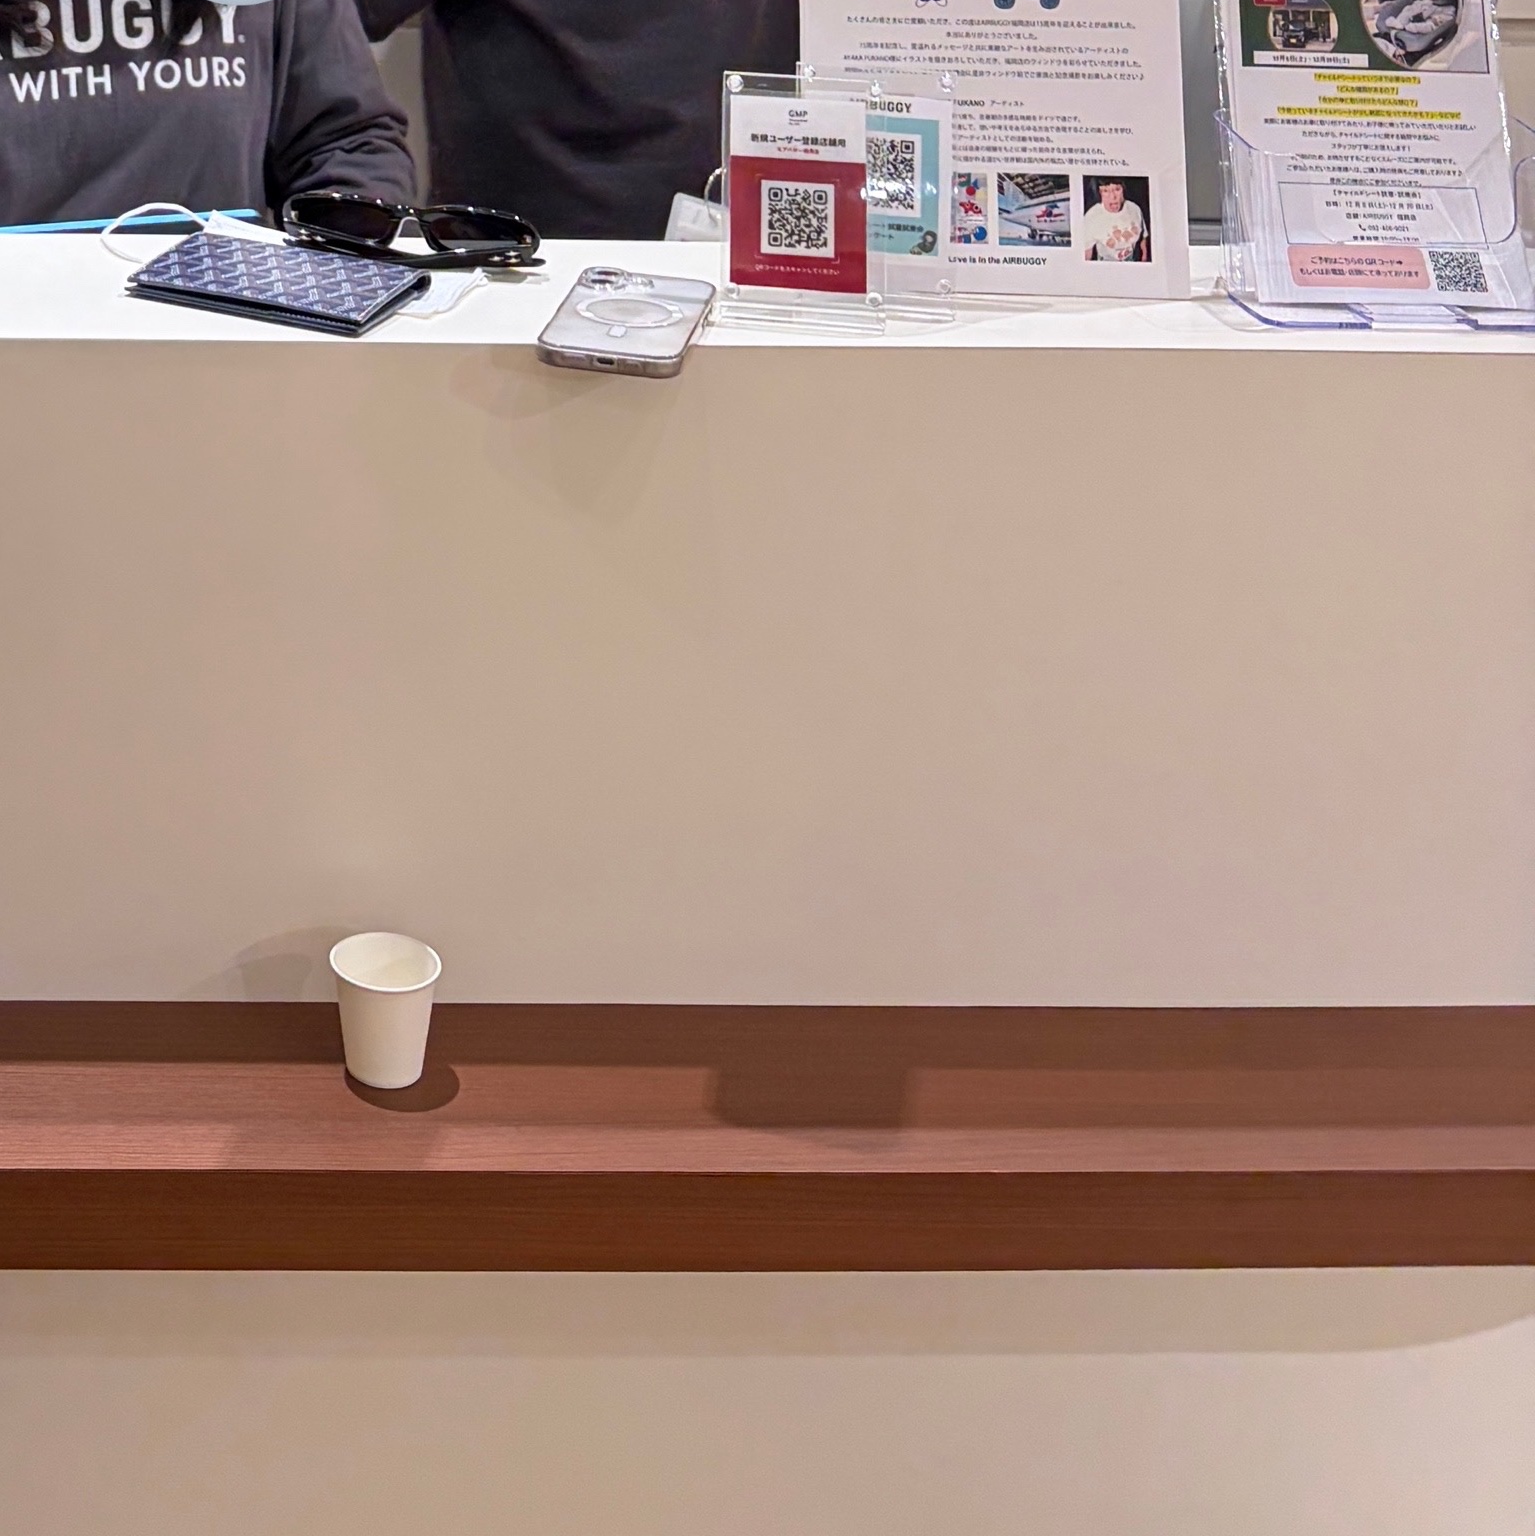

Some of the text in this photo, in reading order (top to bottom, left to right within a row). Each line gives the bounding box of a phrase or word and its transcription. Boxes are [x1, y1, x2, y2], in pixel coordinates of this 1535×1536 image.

[9, 64, 113, 104] WITH
[128, 56, 246, 92] YOURS
[1003, 257, 1047, 265] AIRBUGGY
